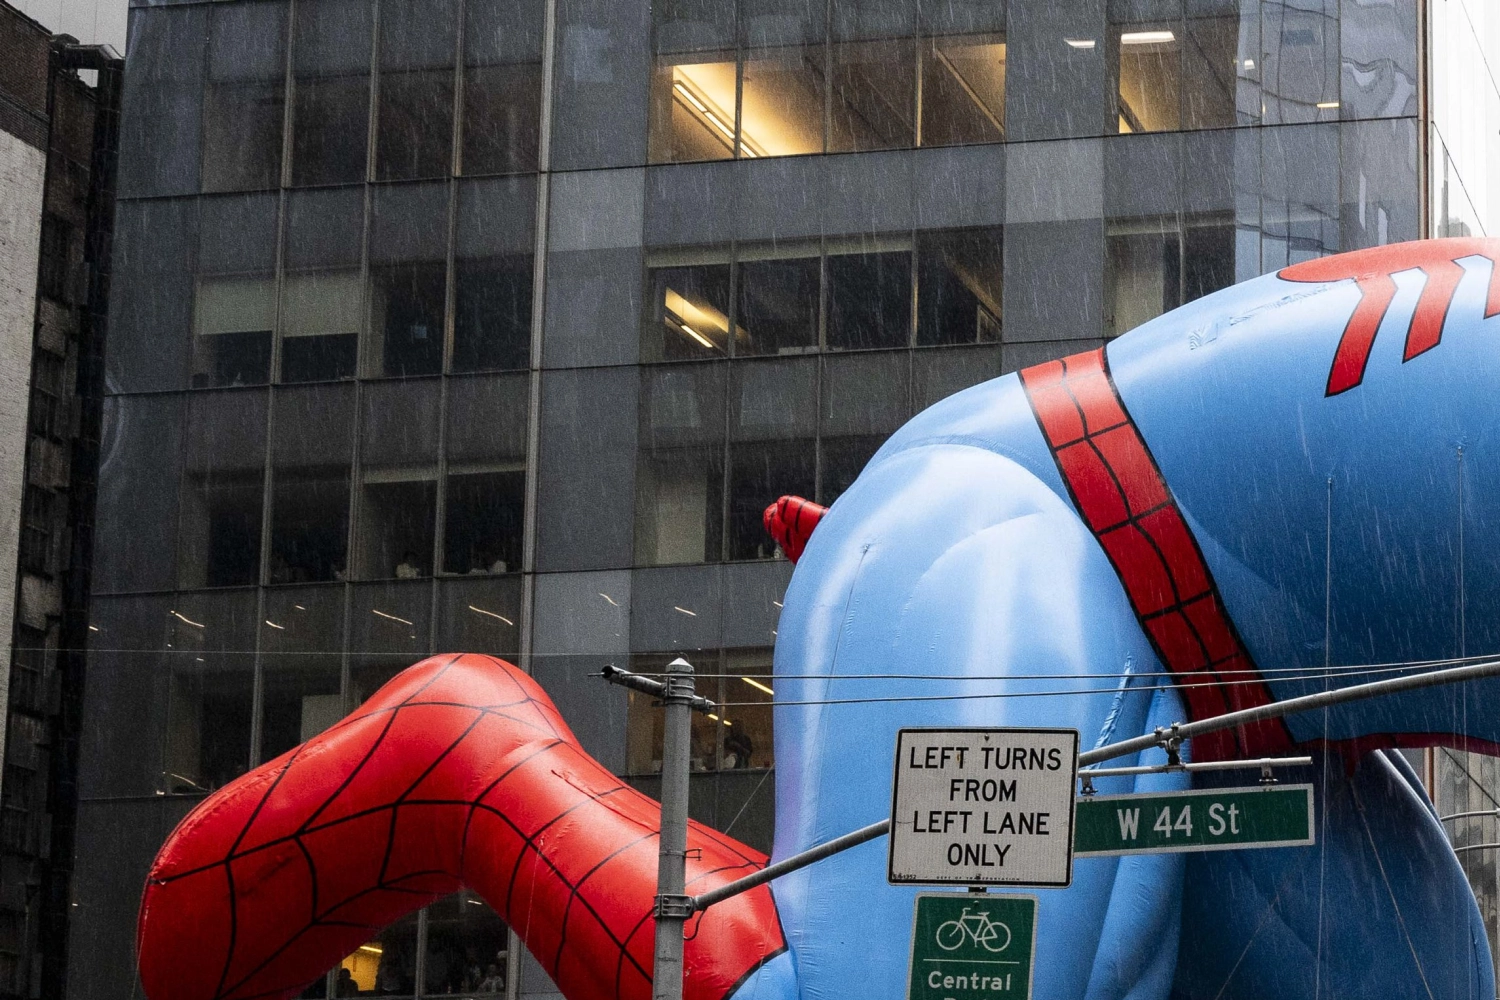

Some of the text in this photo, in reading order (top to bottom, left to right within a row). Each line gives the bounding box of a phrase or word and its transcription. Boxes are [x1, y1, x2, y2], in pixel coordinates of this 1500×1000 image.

[909, 746, 1062, 771] LEFT TURNS
[949, 778, 1017, 802] FROM
[913, 810, 1050, 835] LEFT LANE
[1117, 802, 1239, 840] W 44 St
[947, 842, 1011, 867] ONLY
[928, 970, 1011, 991] Central
